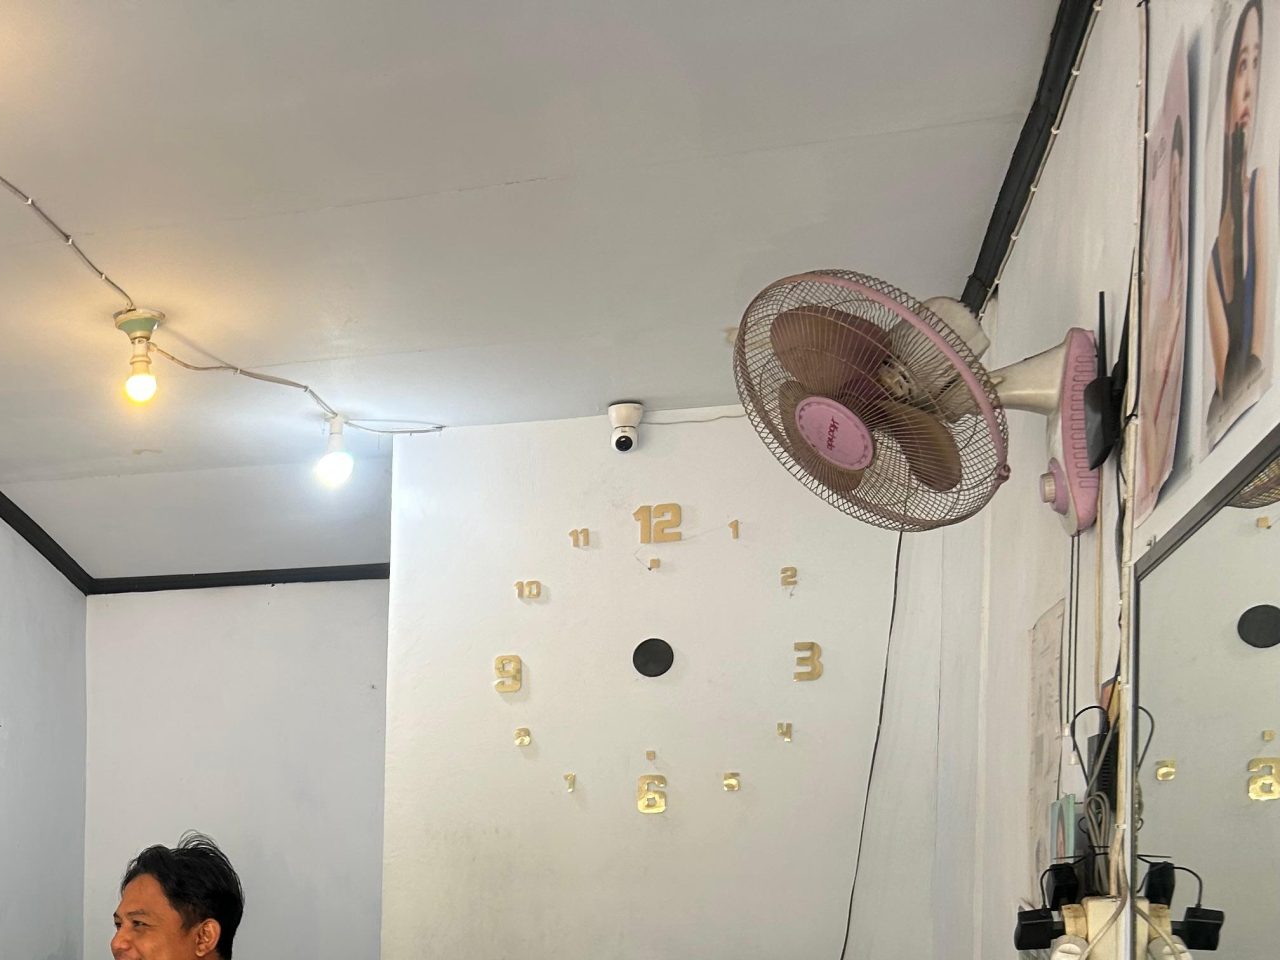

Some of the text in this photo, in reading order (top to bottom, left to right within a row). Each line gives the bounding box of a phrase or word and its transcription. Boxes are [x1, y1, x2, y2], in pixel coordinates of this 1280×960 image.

[632, 503, 682, 544] 12
[728, 520, 740, 539] 1
[568, 528, 590, 547] 11
[780, 567, 798, 586] 2
[514, 580, 542, 599] 10
[793, 641, 822, 682] 3
[494, 655, 522, 693] 9
[513, 727, 532, 746] 8
[776, 722, 793, 742] 4
[564, 772, 576, 793] 7
[723, 772, 741, 792] 5
[637, 774, 667, 814] 6
